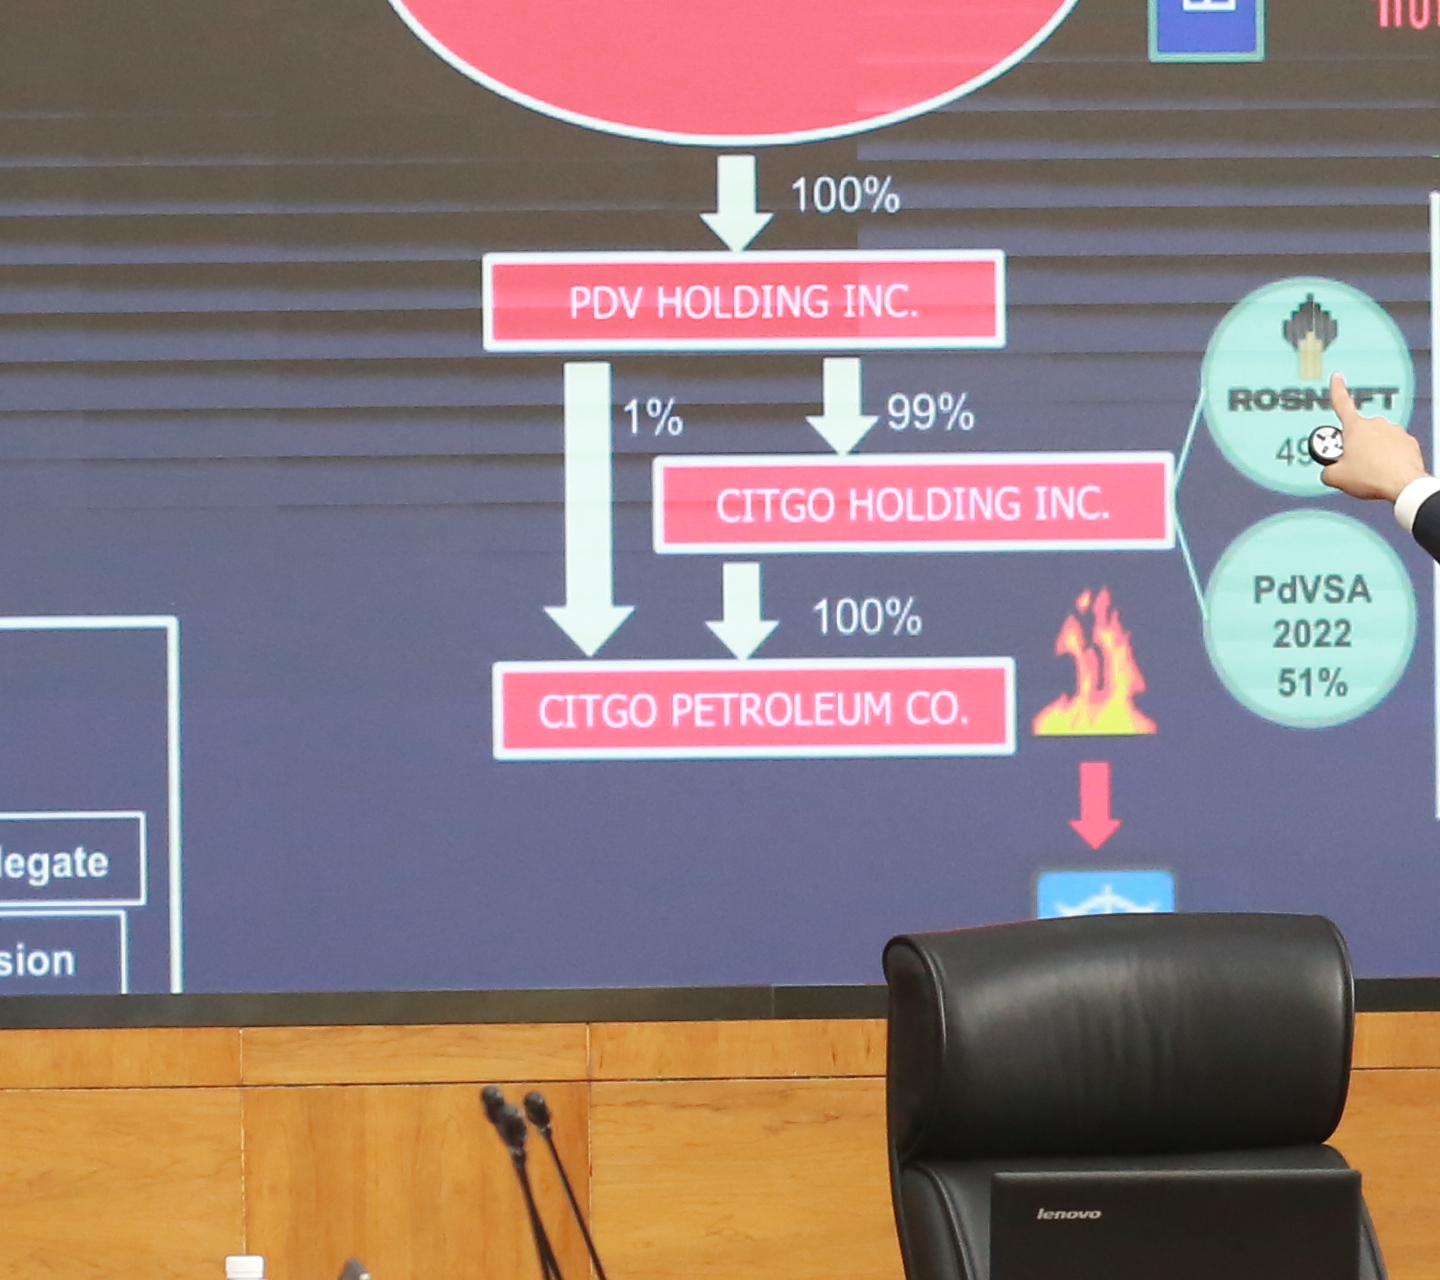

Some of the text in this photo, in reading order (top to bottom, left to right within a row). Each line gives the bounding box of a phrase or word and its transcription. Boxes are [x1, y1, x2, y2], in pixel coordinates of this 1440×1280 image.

[793, 177, 901, 214] 100%
[571, 284, 918, 321] PDV HOLDING INC.
[888, 393, 976, 432] 99%
[1229, 388, 1399, 410] ROSNFT
[625, 399, 684, 437] 1%
[718, 486, 1111, 524] CITGO HOLDING INC.
[1255, 574, 1373, 605] PdVSA
[815, 598, 923, 636] 100%
[1274, 619, 1352, 649] 2022
[1279, 668, 1349, 699] 51%
[540, 691, 969, 730] CITGO PETROLEUM CO.
[1037, 1208, 1102, 1220] lenovo
